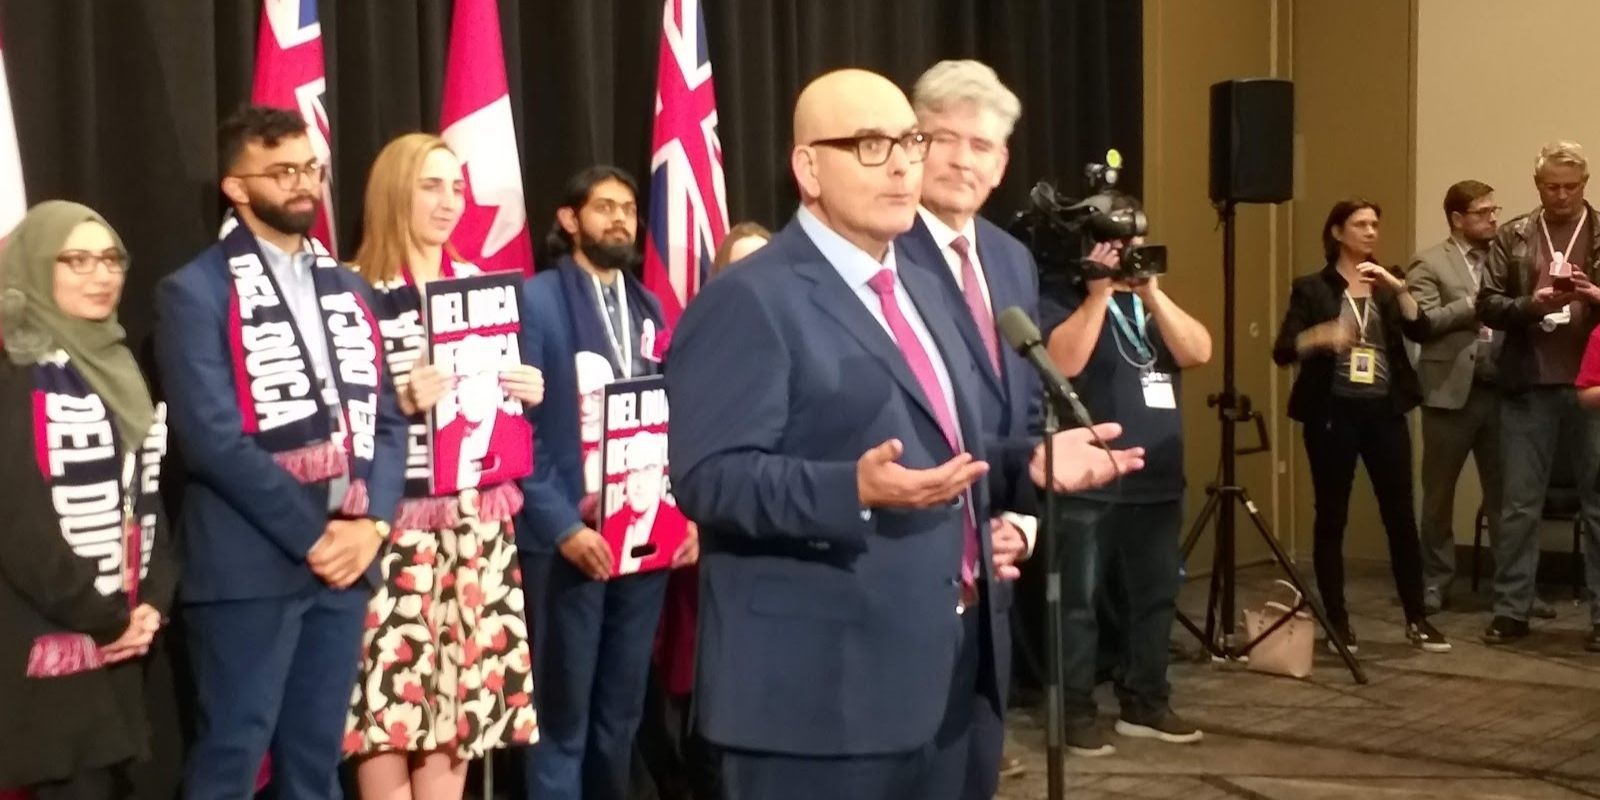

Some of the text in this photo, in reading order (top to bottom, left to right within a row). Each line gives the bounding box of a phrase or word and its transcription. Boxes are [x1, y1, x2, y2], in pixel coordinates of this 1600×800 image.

[228, 252, 319, 432] DEL DUCA
[320, 291, 378, 388] DUCA
[431, 285, 520, 334] DEL DUCA
[45, 392, 116, 477] DEL
[347, 393, 378, 461] DEL
[607, 392, 641, 431] DEL
